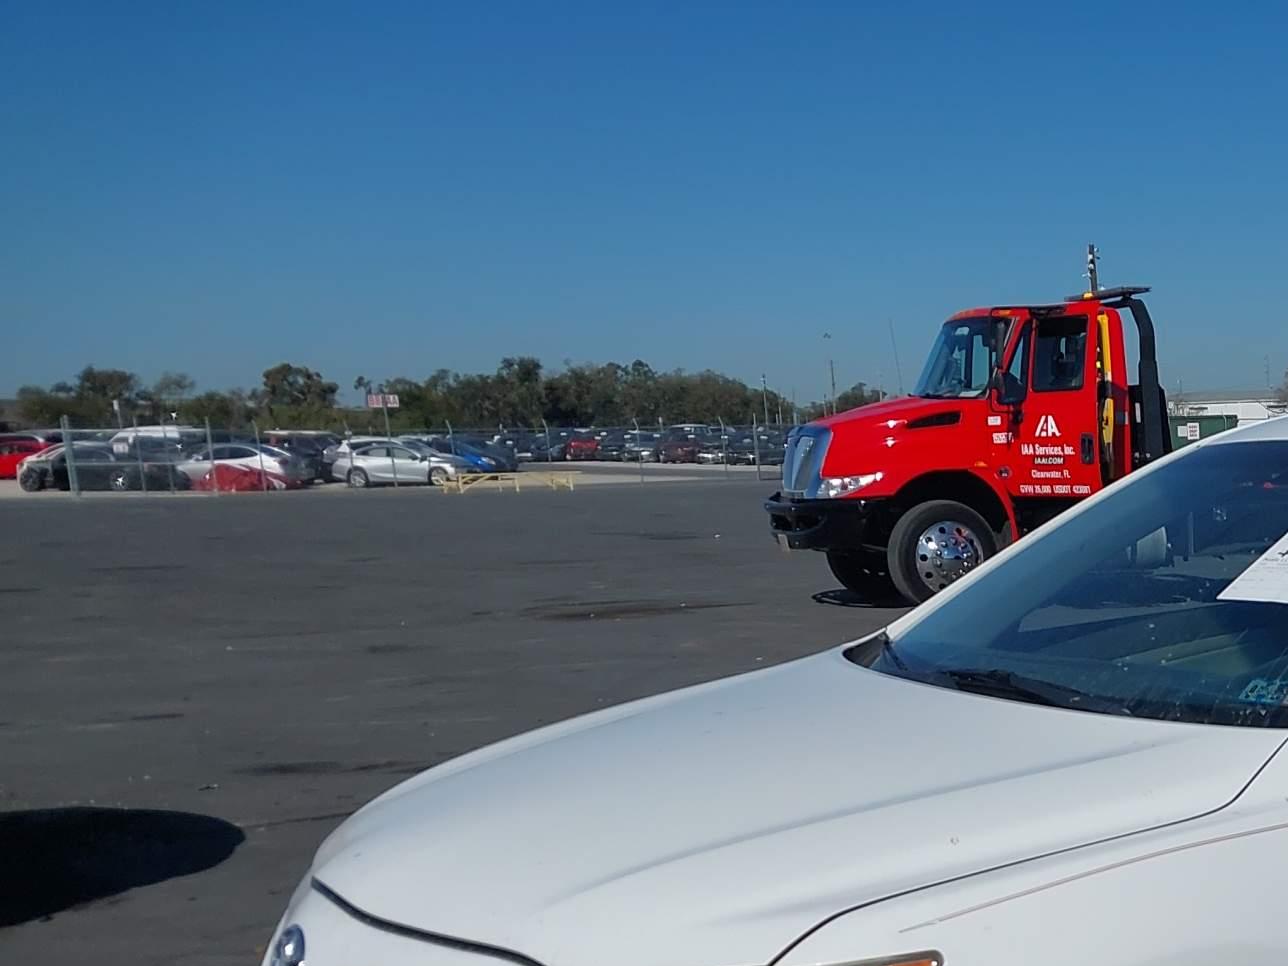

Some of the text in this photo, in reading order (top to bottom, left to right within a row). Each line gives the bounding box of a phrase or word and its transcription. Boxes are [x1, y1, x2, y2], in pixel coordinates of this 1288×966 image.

[1021, 443, 1076, 456] IAA Services, Inc.
